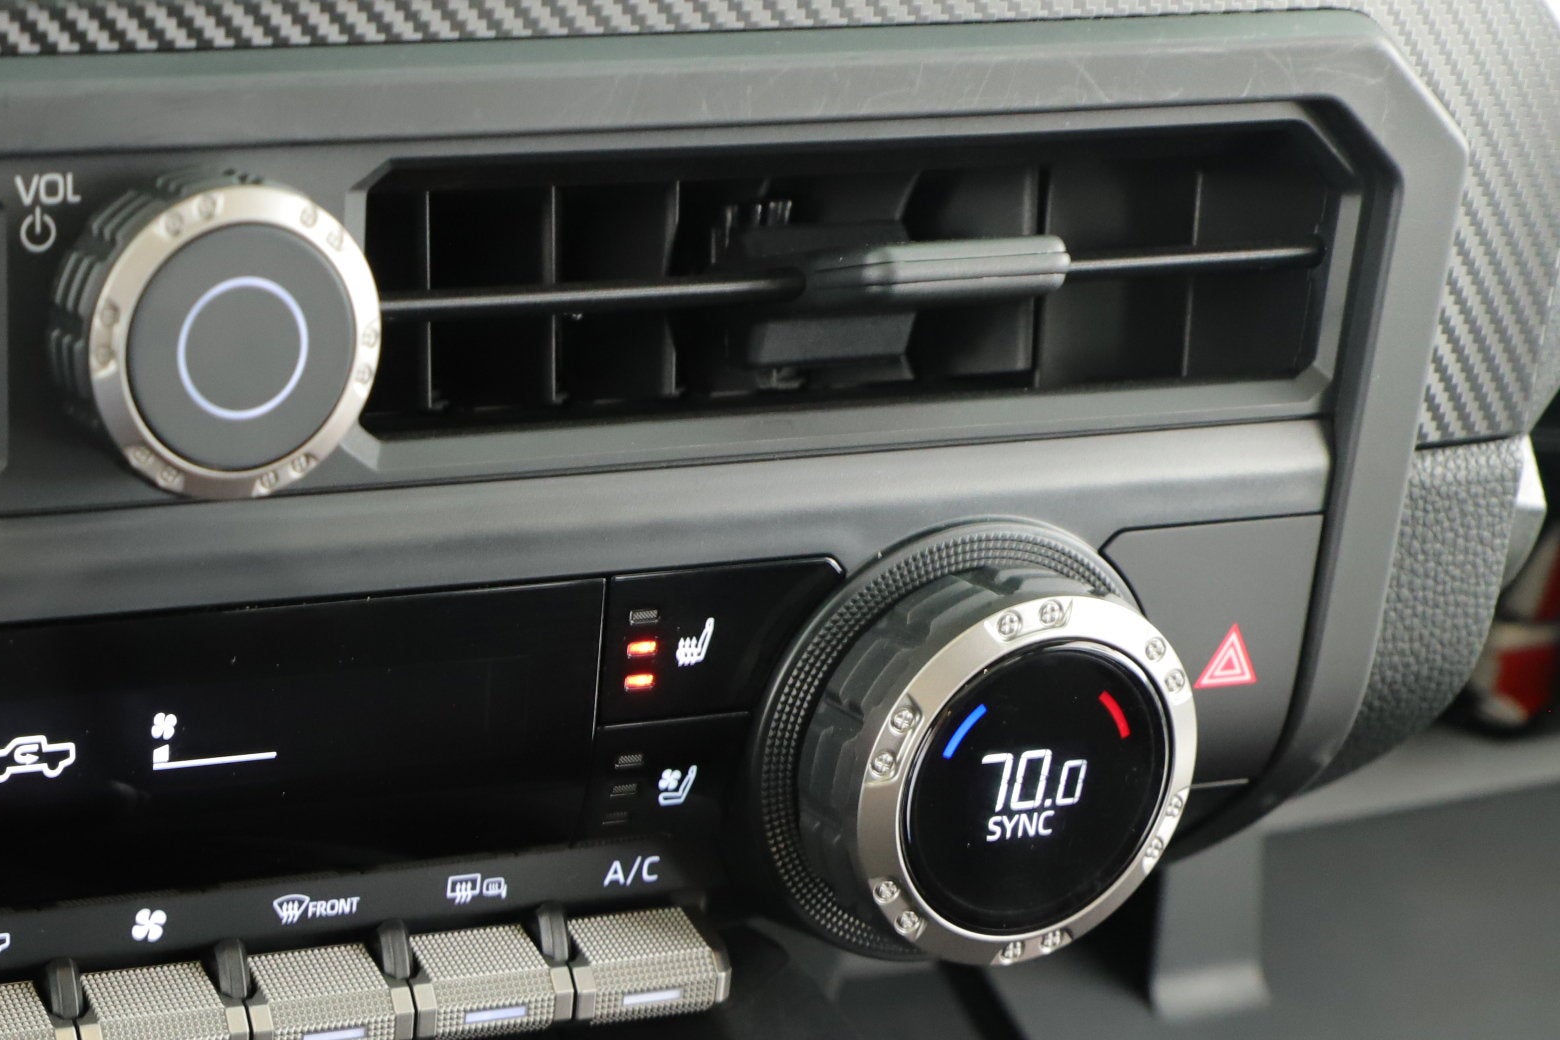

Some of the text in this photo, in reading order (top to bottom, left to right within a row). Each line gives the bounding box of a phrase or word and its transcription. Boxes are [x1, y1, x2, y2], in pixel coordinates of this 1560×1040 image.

[14, 172, 81, 206] VOL
[981, 748, 1088, 813] 70.0
[986, 810, 1056, 842] SYNC
[603, 855, 660, 887] A/C
[307, 895, 361, 918] FRONT
